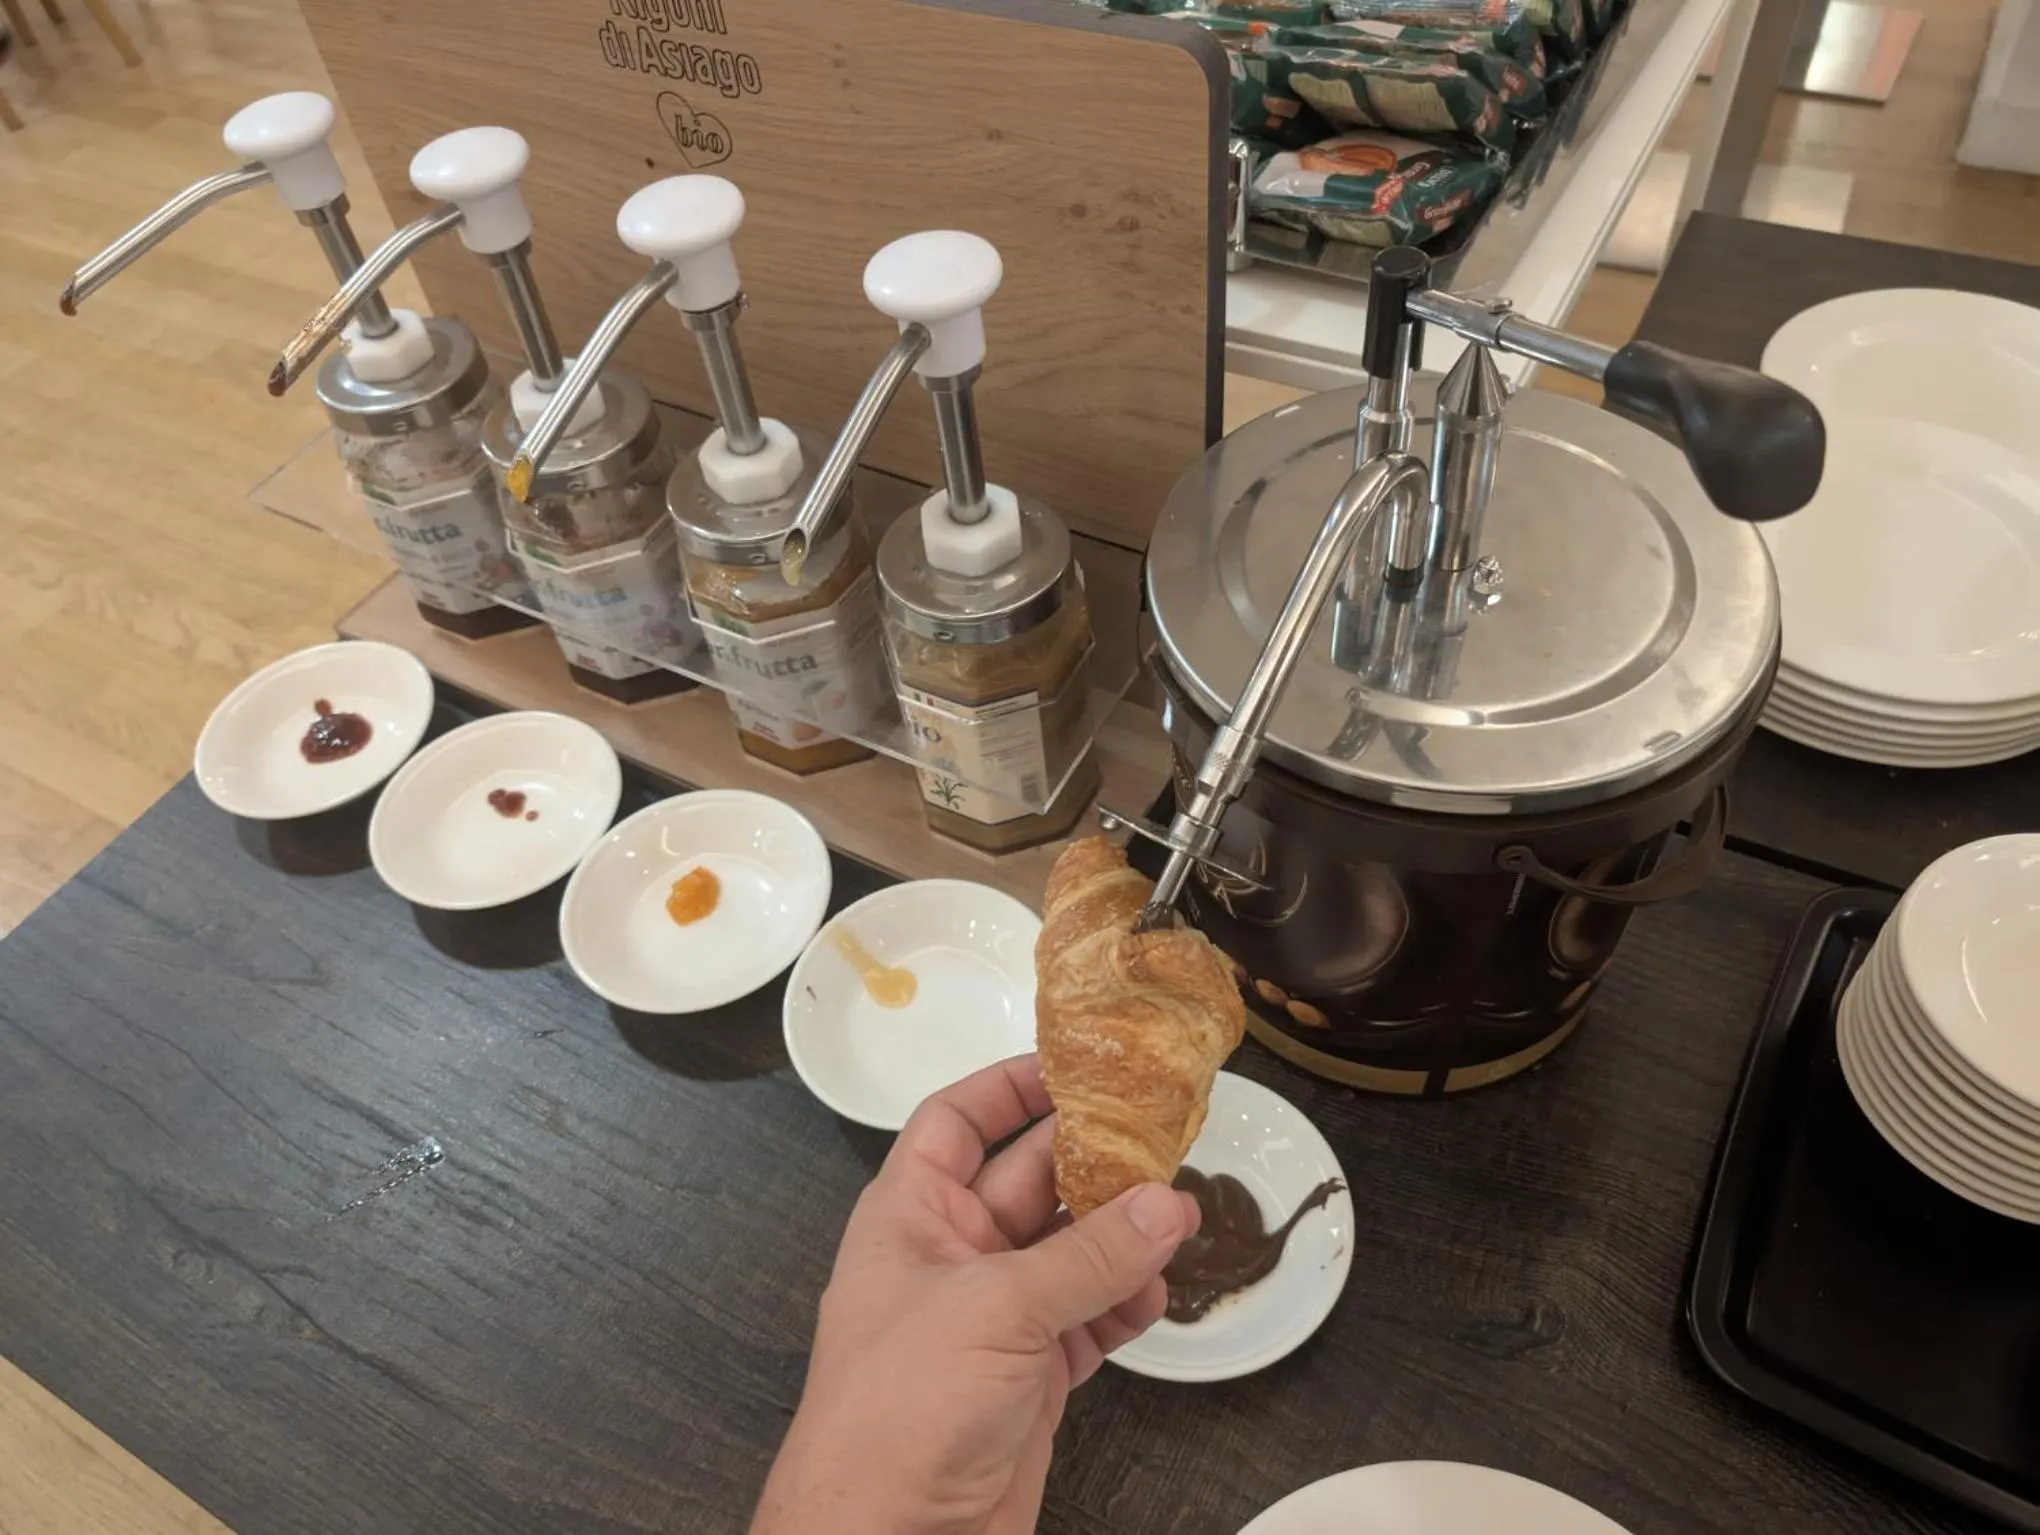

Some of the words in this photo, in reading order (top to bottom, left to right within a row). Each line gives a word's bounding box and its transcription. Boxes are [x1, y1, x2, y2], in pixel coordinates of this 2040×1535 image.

[599, 20, 636, 70] di
[637, 26, 762, 98] Asiago
[675, 114, 724, 154] bio
